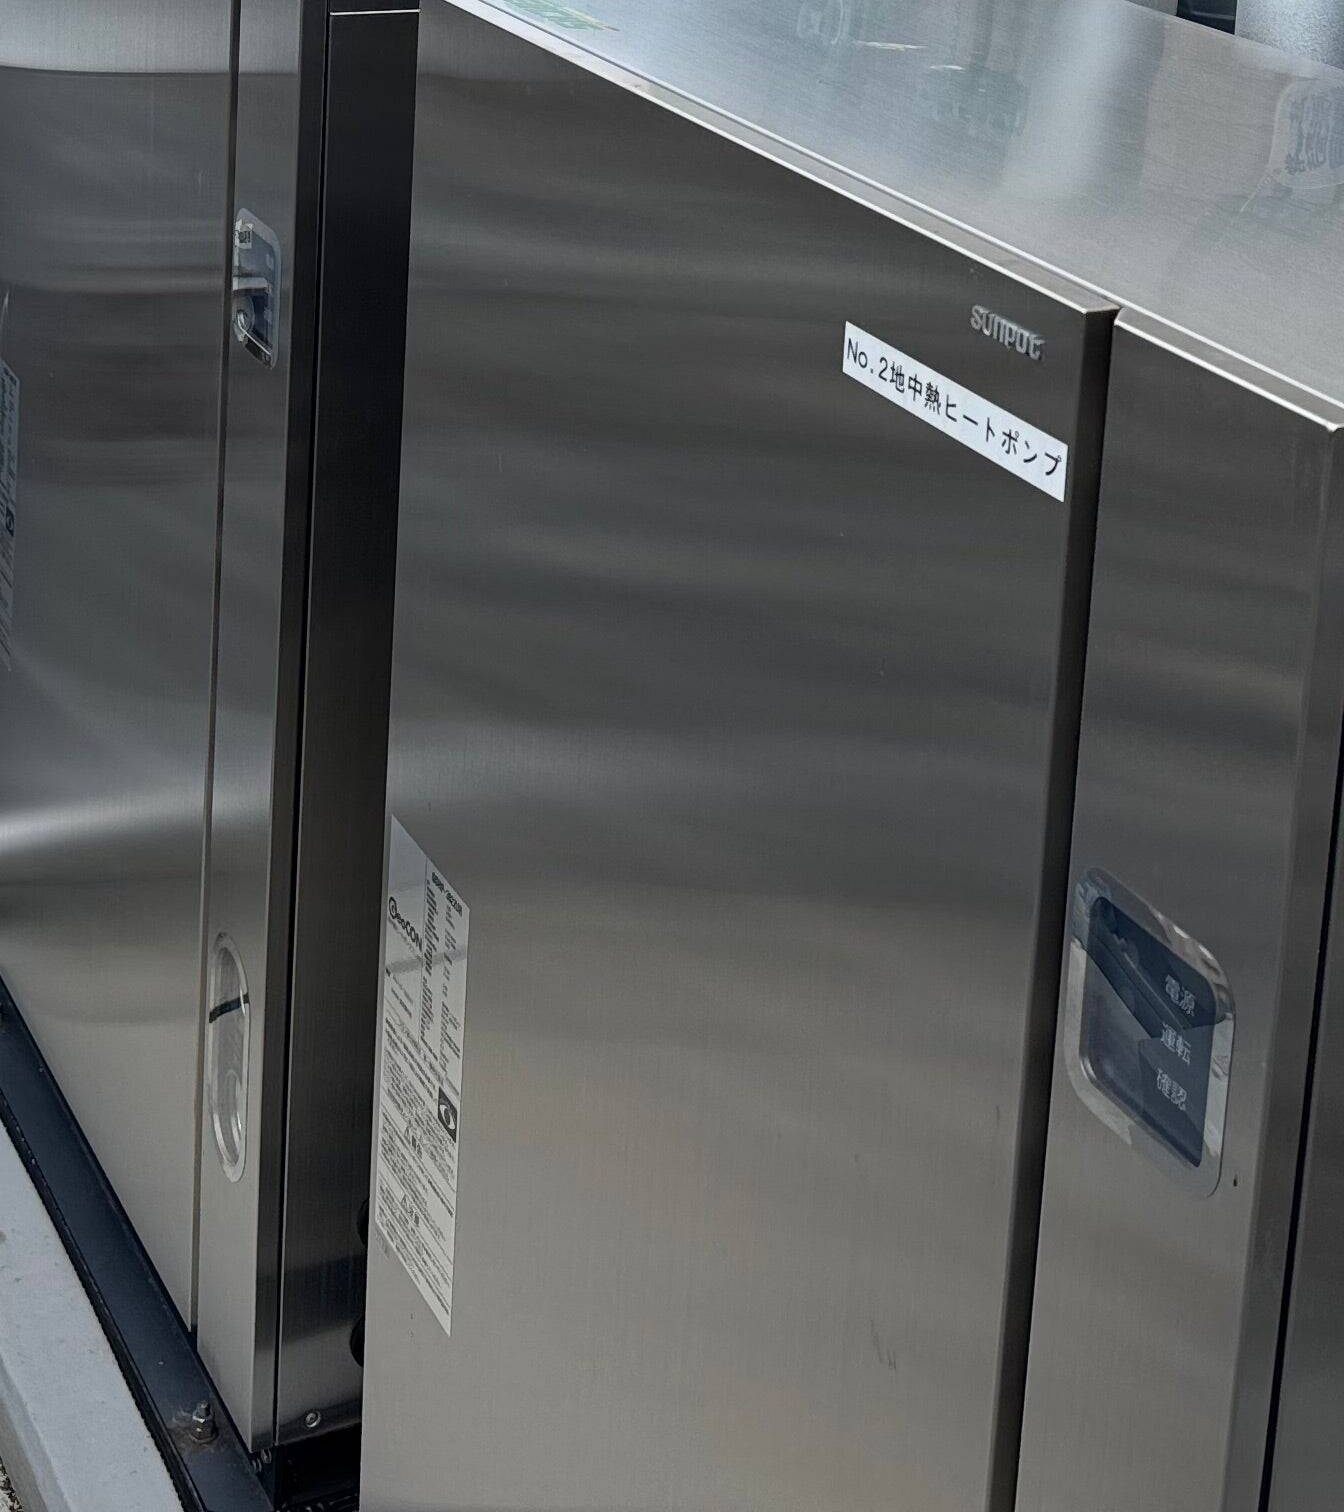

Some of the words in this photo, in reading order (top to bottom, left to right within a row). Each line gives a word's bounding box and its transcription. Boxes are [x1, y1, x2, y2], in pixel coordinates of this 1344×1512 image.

[847, 337, 1063, 477] No.2地中熱ヒートポンプ
